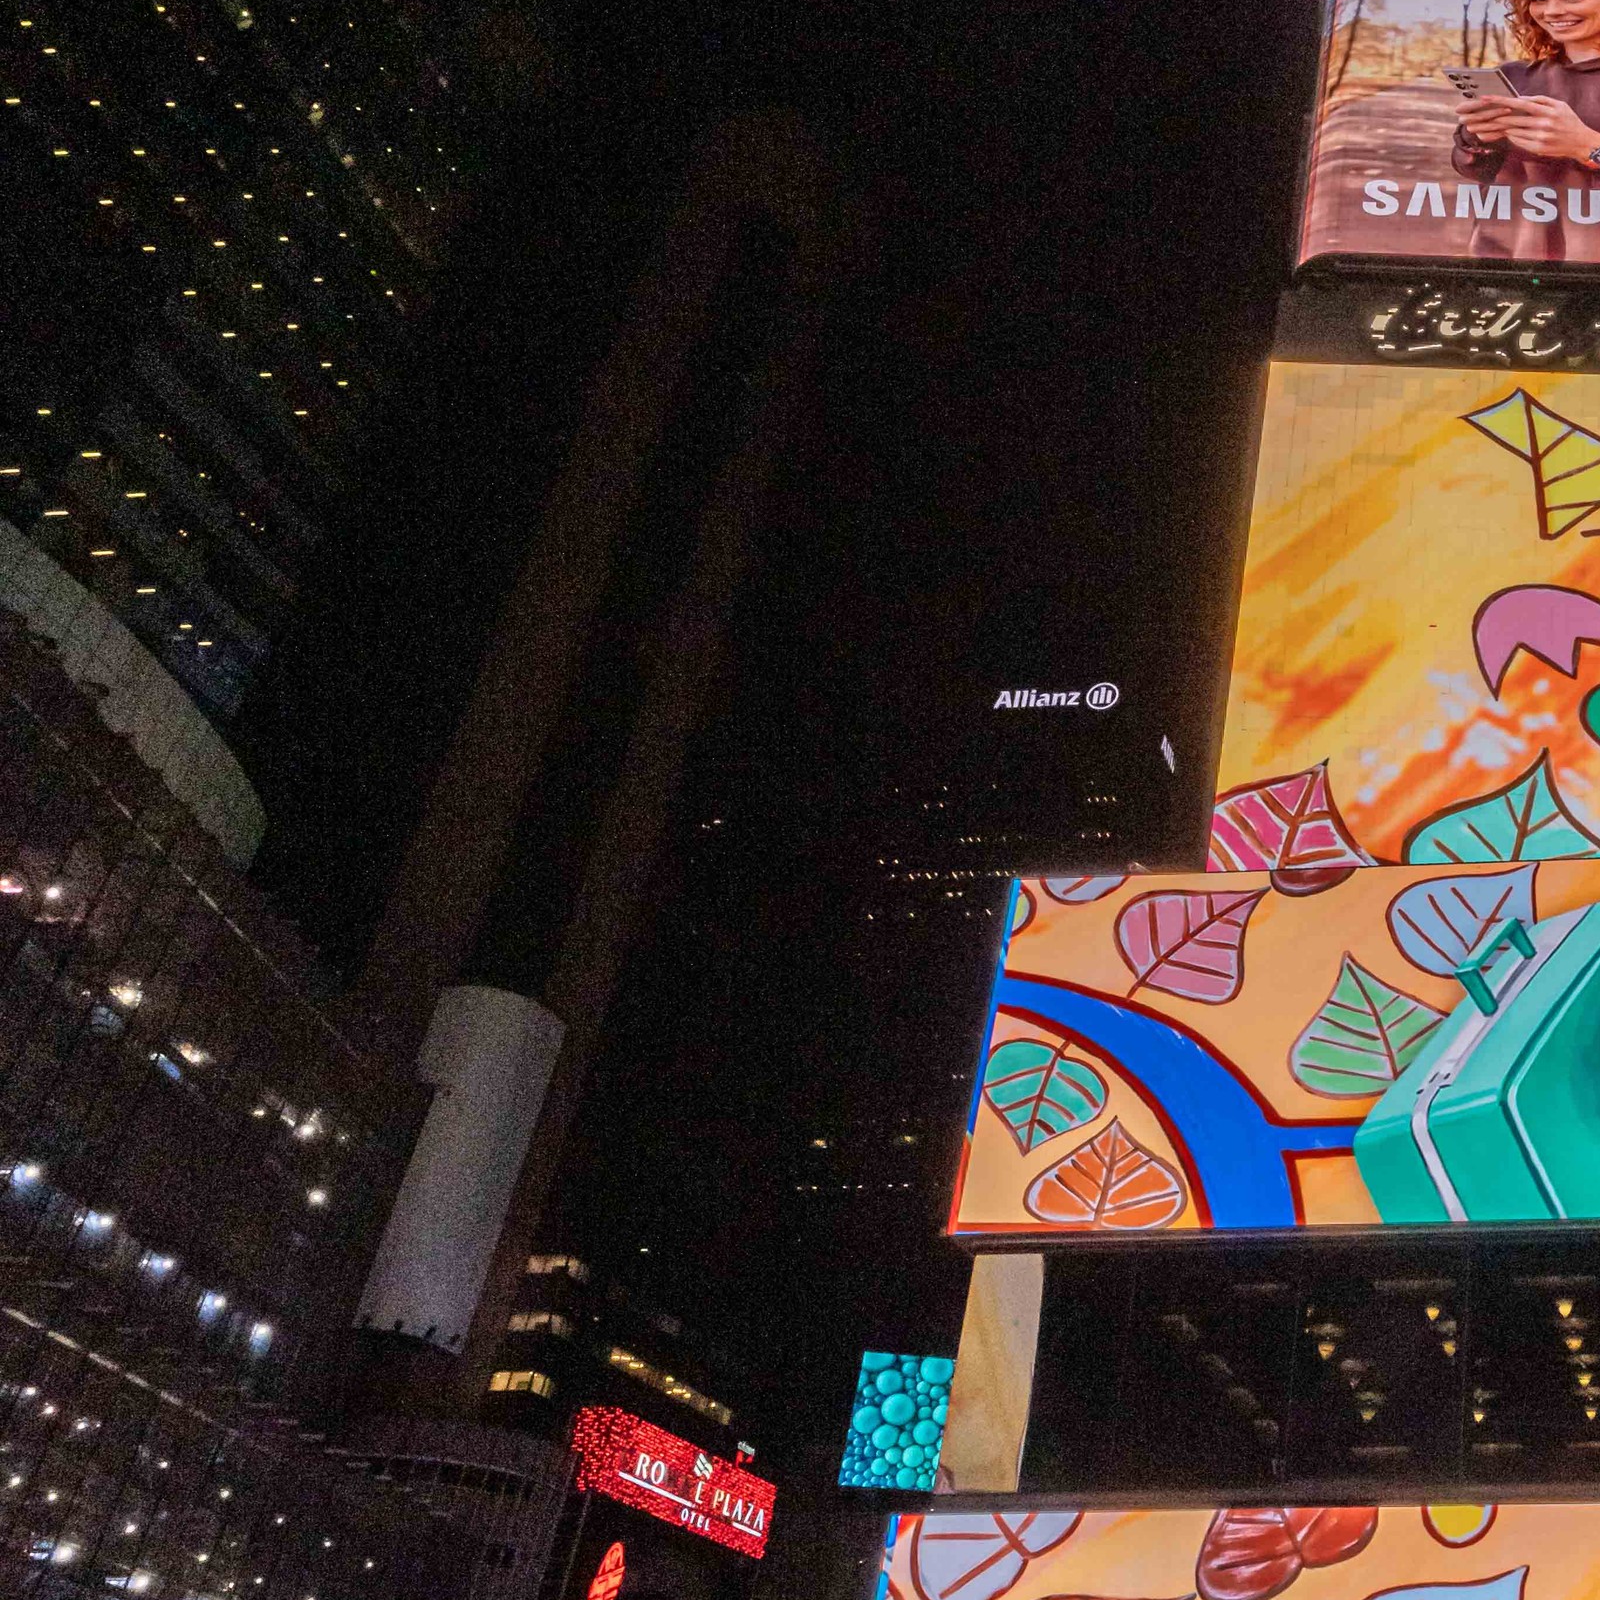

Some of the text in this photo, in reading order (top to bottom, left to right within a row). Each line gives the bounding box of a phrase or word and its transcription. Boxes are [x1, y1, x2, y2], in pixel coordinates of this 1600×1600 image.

[993, 689, 1080, 709] Allianz
[681, 1508, 710, 1531] OTEL
[713, 1488, 765, 1531] PLAZA
